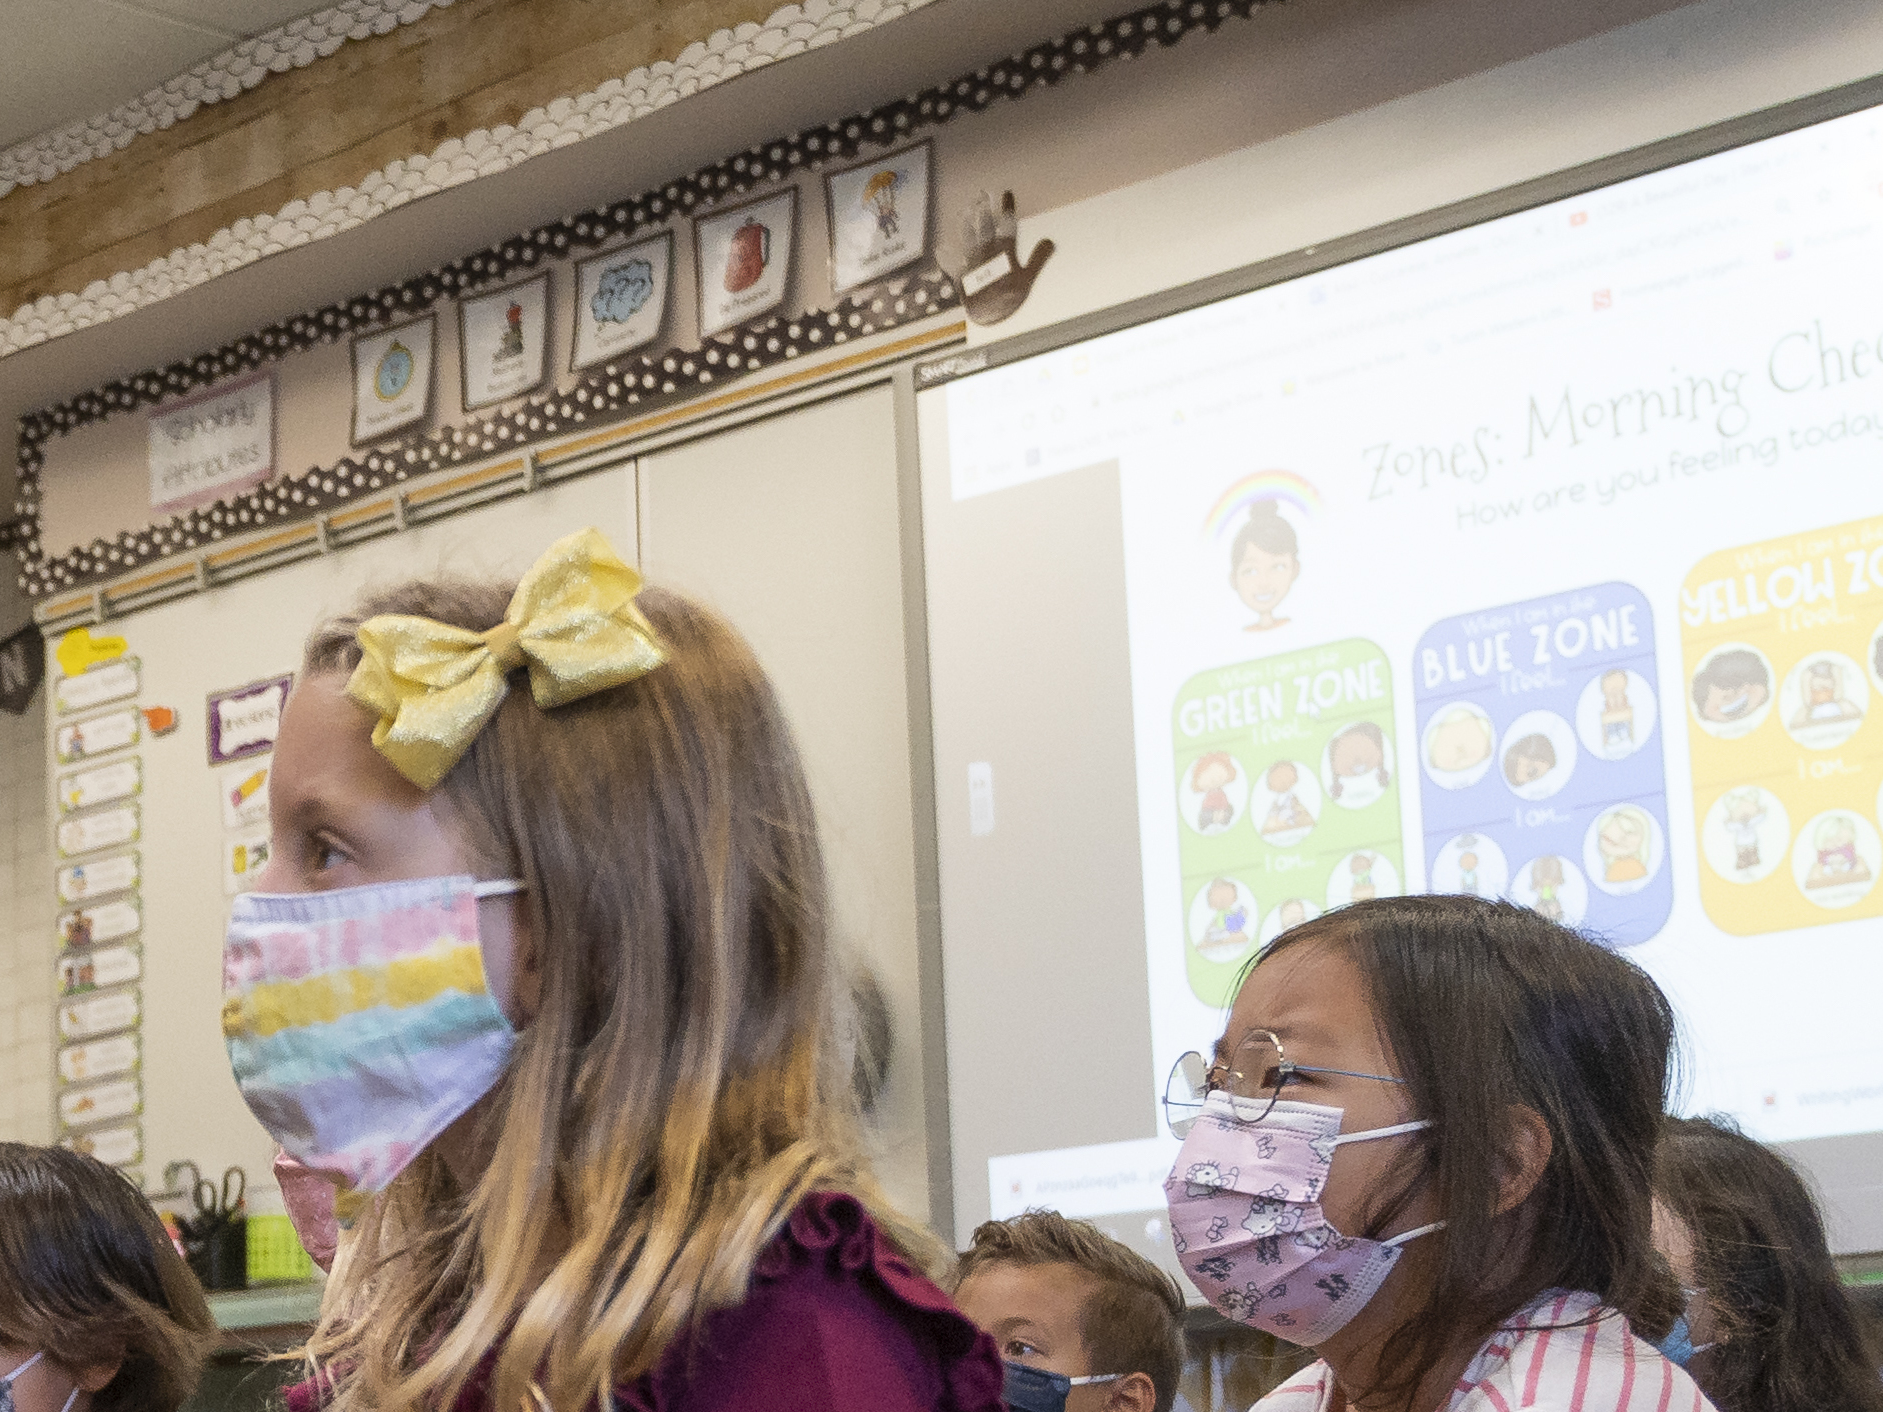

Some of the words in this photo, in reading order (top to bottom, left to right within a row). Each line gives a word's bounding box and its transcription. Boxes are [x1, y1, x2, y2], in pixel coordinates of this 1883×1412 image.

[1361, 425, 1504, 502] Zones:
[1521, 365, 1750, 460] Morning
[1455, 495, 1524, 531] How
[1531, 481, 1587, 513] are
[1594, 464, 1660, 508] you
[1667, 436, 1779, 481] feeling
[1680, 555, 1836, 628] YELLOW
[1420, 631, 1514, 690] BLUE
[1528, 602, 1640, 666] ZONE
[1178, 680, 1283, 738] GREEN
[1292, 658, 1386, 716] ZONE
